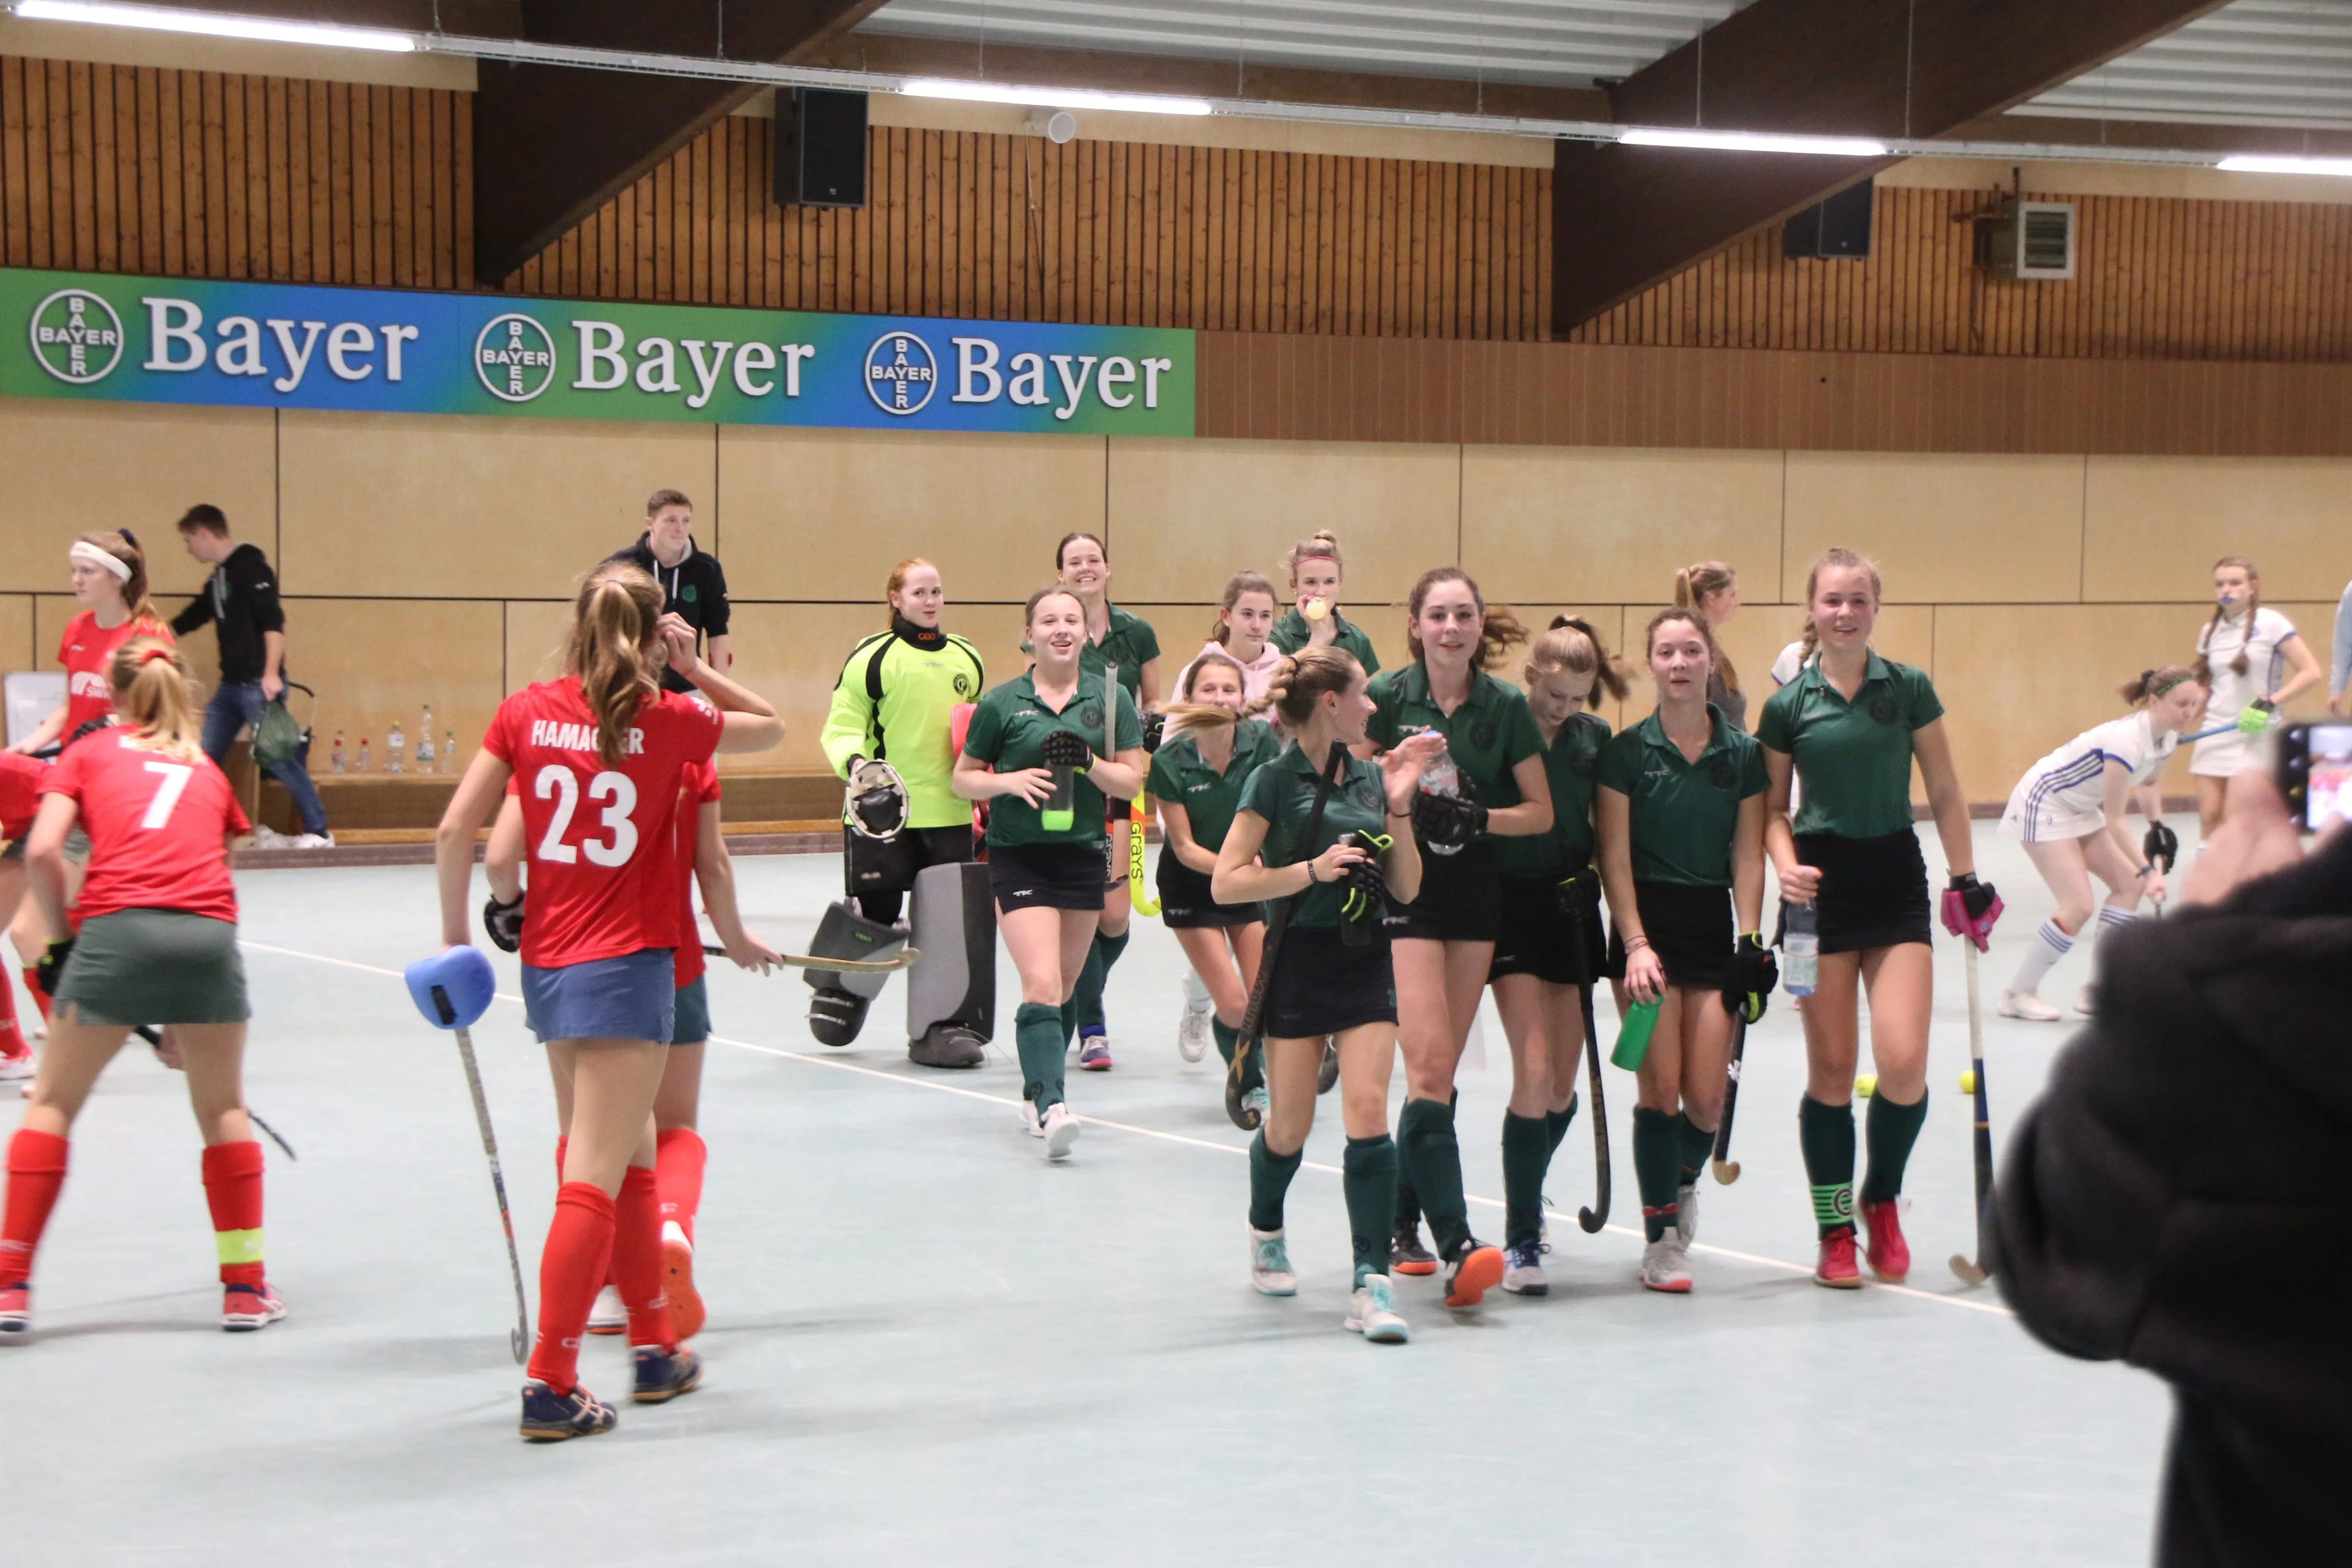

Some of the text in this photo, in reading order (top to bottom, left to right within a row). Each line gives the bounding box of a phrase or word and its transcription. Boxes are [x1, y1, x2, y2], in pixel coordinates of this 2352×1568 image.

[40, 327, 117, 346] BAYER
[69, 297, 88, 376] BAYER
[142, 296, 419, 392] Bayer
[482, 349, 549, 366] BAYER
[509, 322, 524, 394] BAYER
[572, 320, 815, 408] Bayer
[871, 366, 932, 381] BAYER
[895, 339, 908, 408] BAYER
[952, 337, 1171, 419] Bayer
[531, 720, 645, 754] HAMACER
[141, 761, 194, 829] 7
[535, 764, 639, 867] 23
